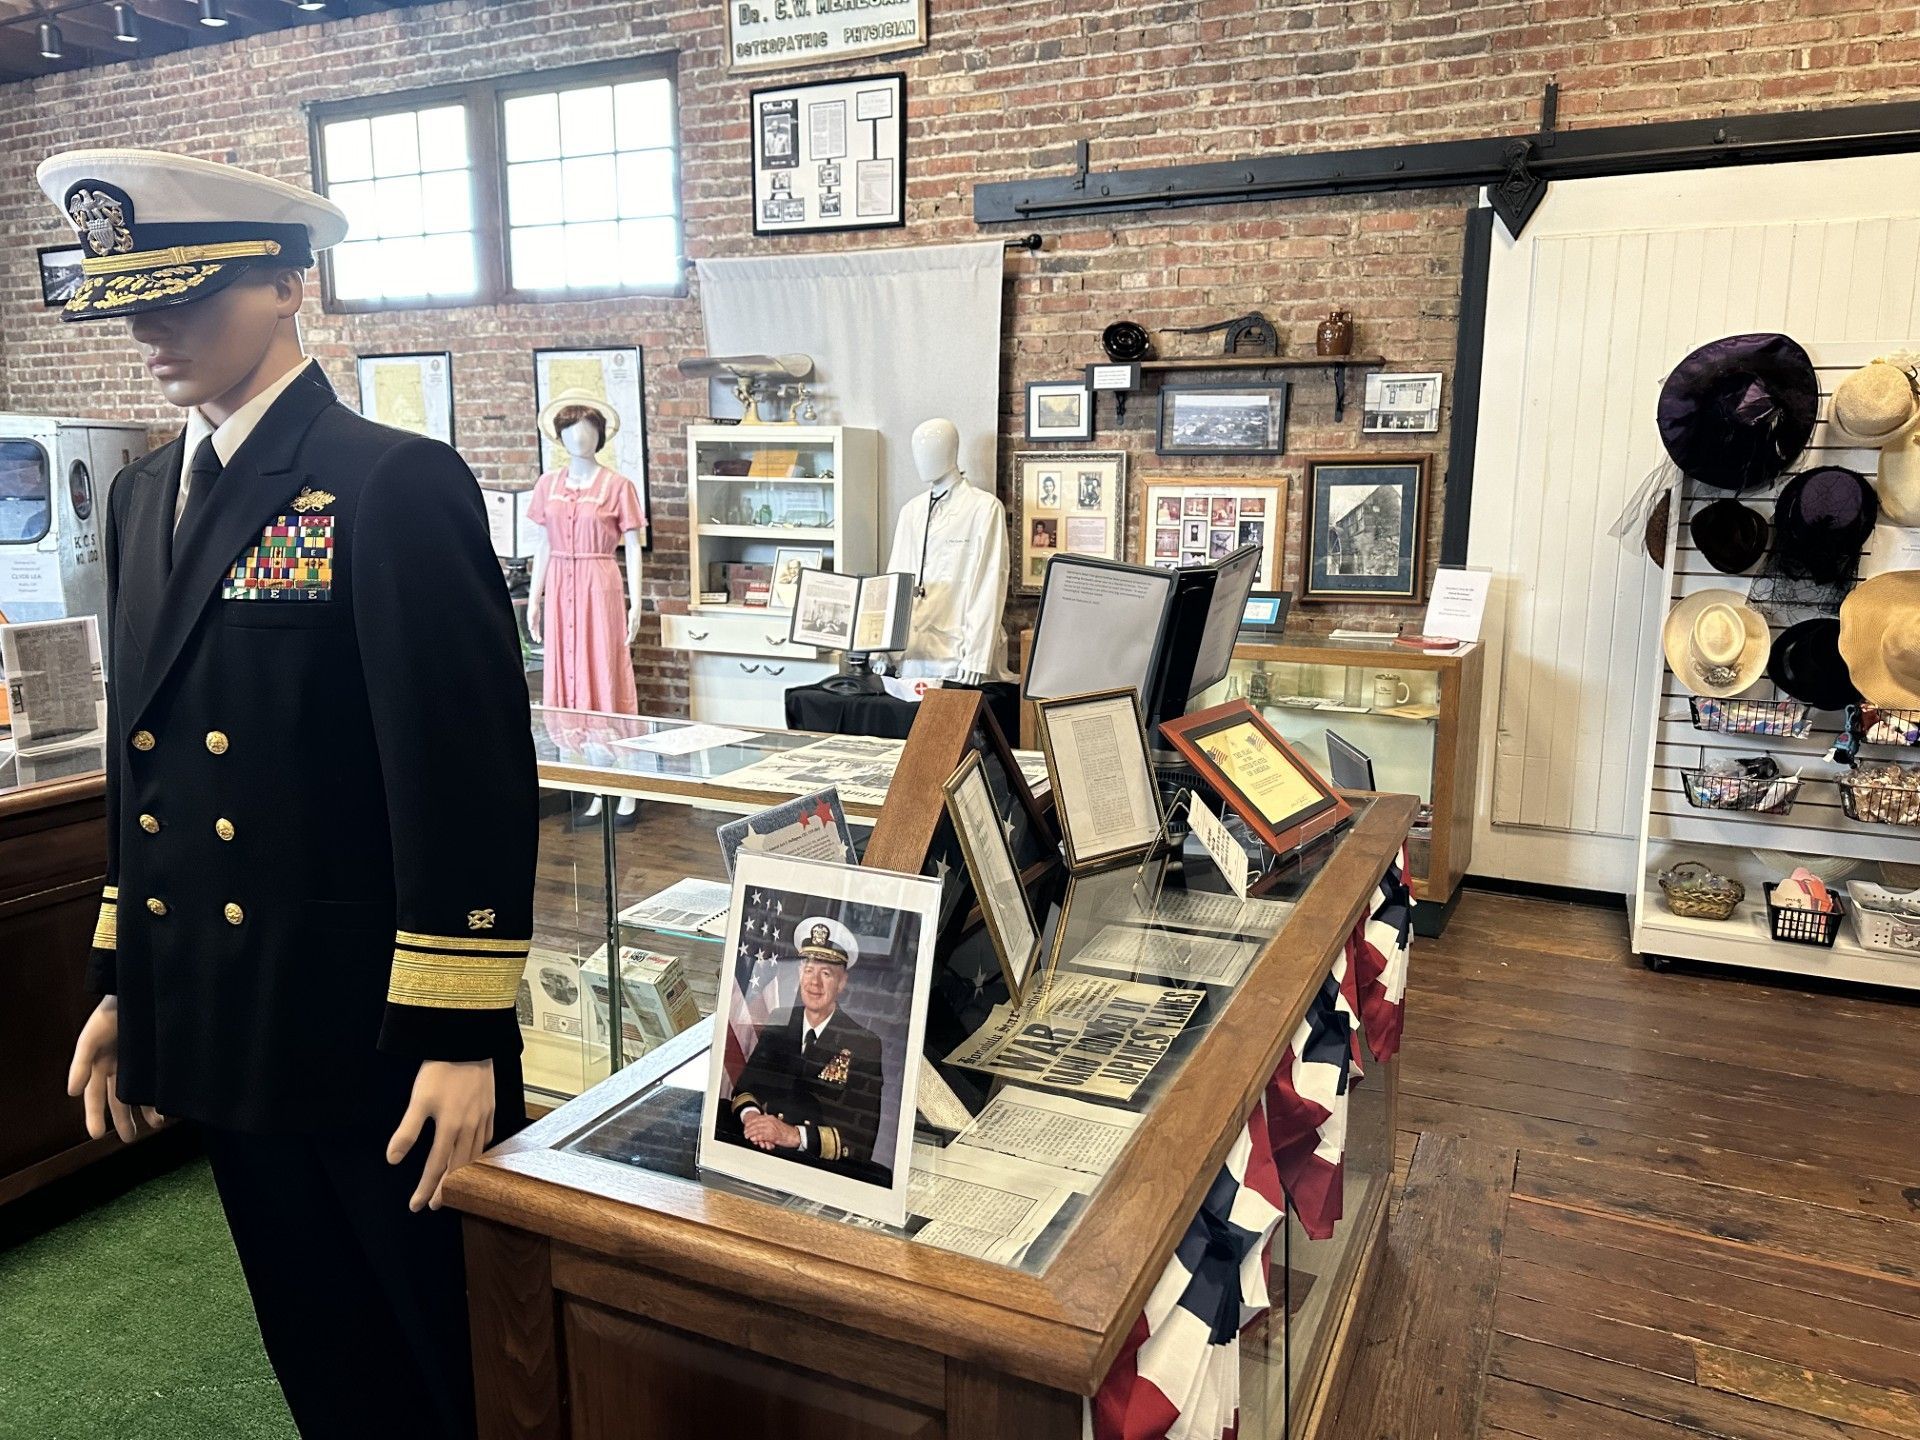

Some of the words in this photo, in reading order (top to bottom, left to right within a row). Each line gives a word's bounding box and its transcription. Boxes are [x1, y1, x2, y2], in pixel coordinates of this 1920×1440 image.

[735, 31, 828, 58] OSTEOPATHIC
[843, 19, 916, 43] PHYSICIAN
[1141, 991, 1201, 1030] PLANES
[988, 1023, 1080, 1073] WAR
[1043, 1054, 1103, 1086] OAHU
[1107, 996, 1151, 1014] BY
